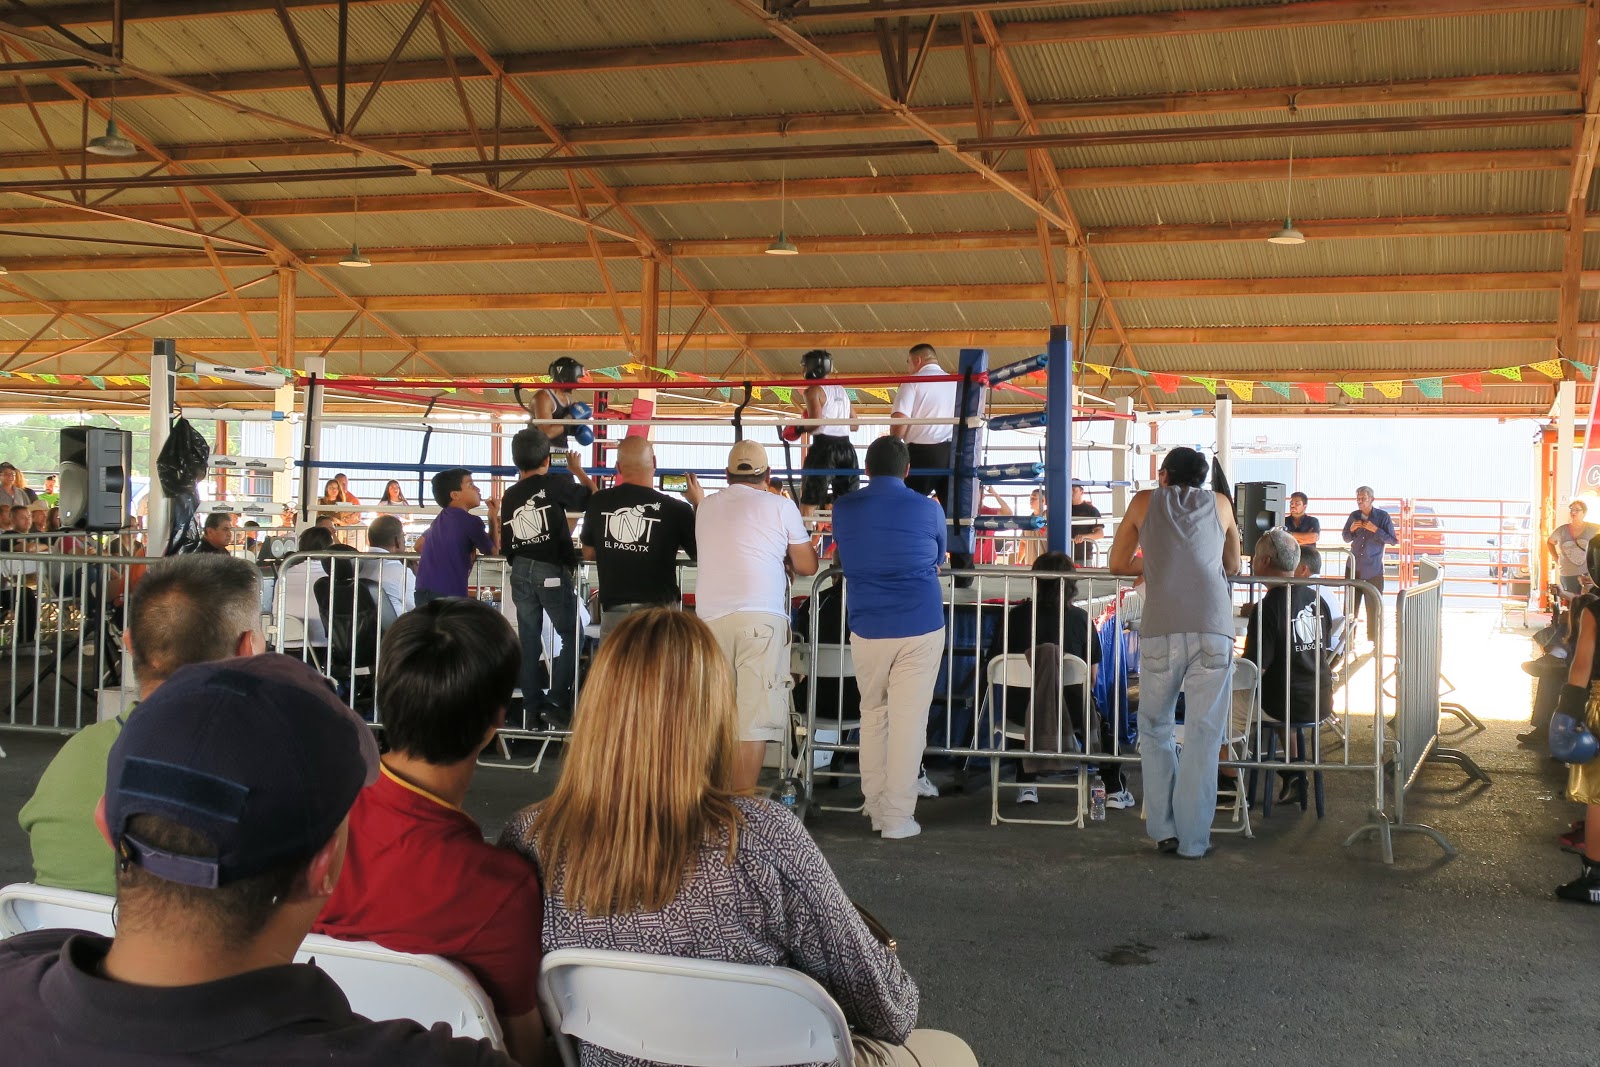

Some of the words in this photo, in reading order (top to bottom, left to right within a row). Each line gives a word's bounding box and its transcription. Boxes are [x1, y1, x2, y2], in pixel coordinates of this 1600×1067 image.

[503, 505, 551, 542] TNT
[601, 512, 661, 543] TNT
[604, 541, 612, 549] EL
[613, 542, 649, 553] PASO,TX
[1291, 614, 1324, 643] TNT
